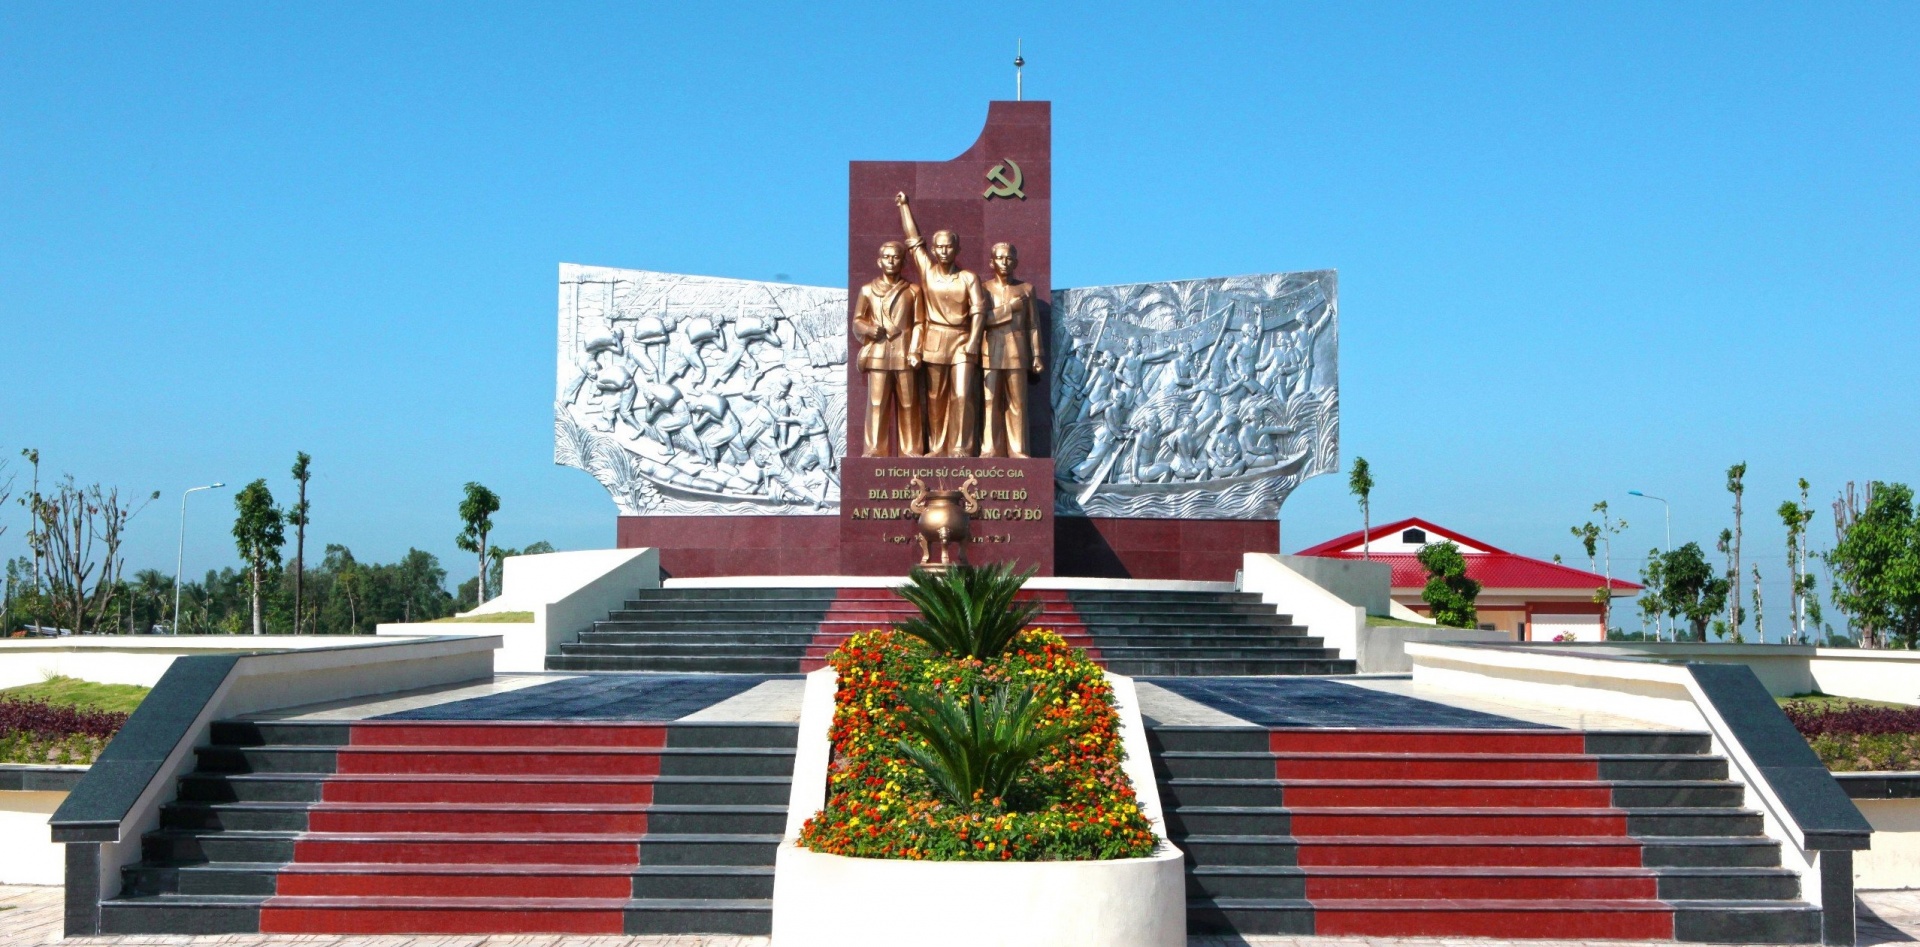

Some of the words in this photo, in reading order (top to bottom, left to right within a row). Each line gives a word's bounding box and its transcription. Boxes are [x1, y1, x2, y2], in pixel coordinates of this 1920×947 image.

[875, 468, 885, 477] DI
[888, 466, 910, 477] TÍCH
[974, 465, 1005, 478] QUỐC
[1006, 469, 1024, 478] GIA
[990, 490, 1010, 500] CHI
[852, 507, 870, 519] AN
[873, 507, 901, 519] NAM
